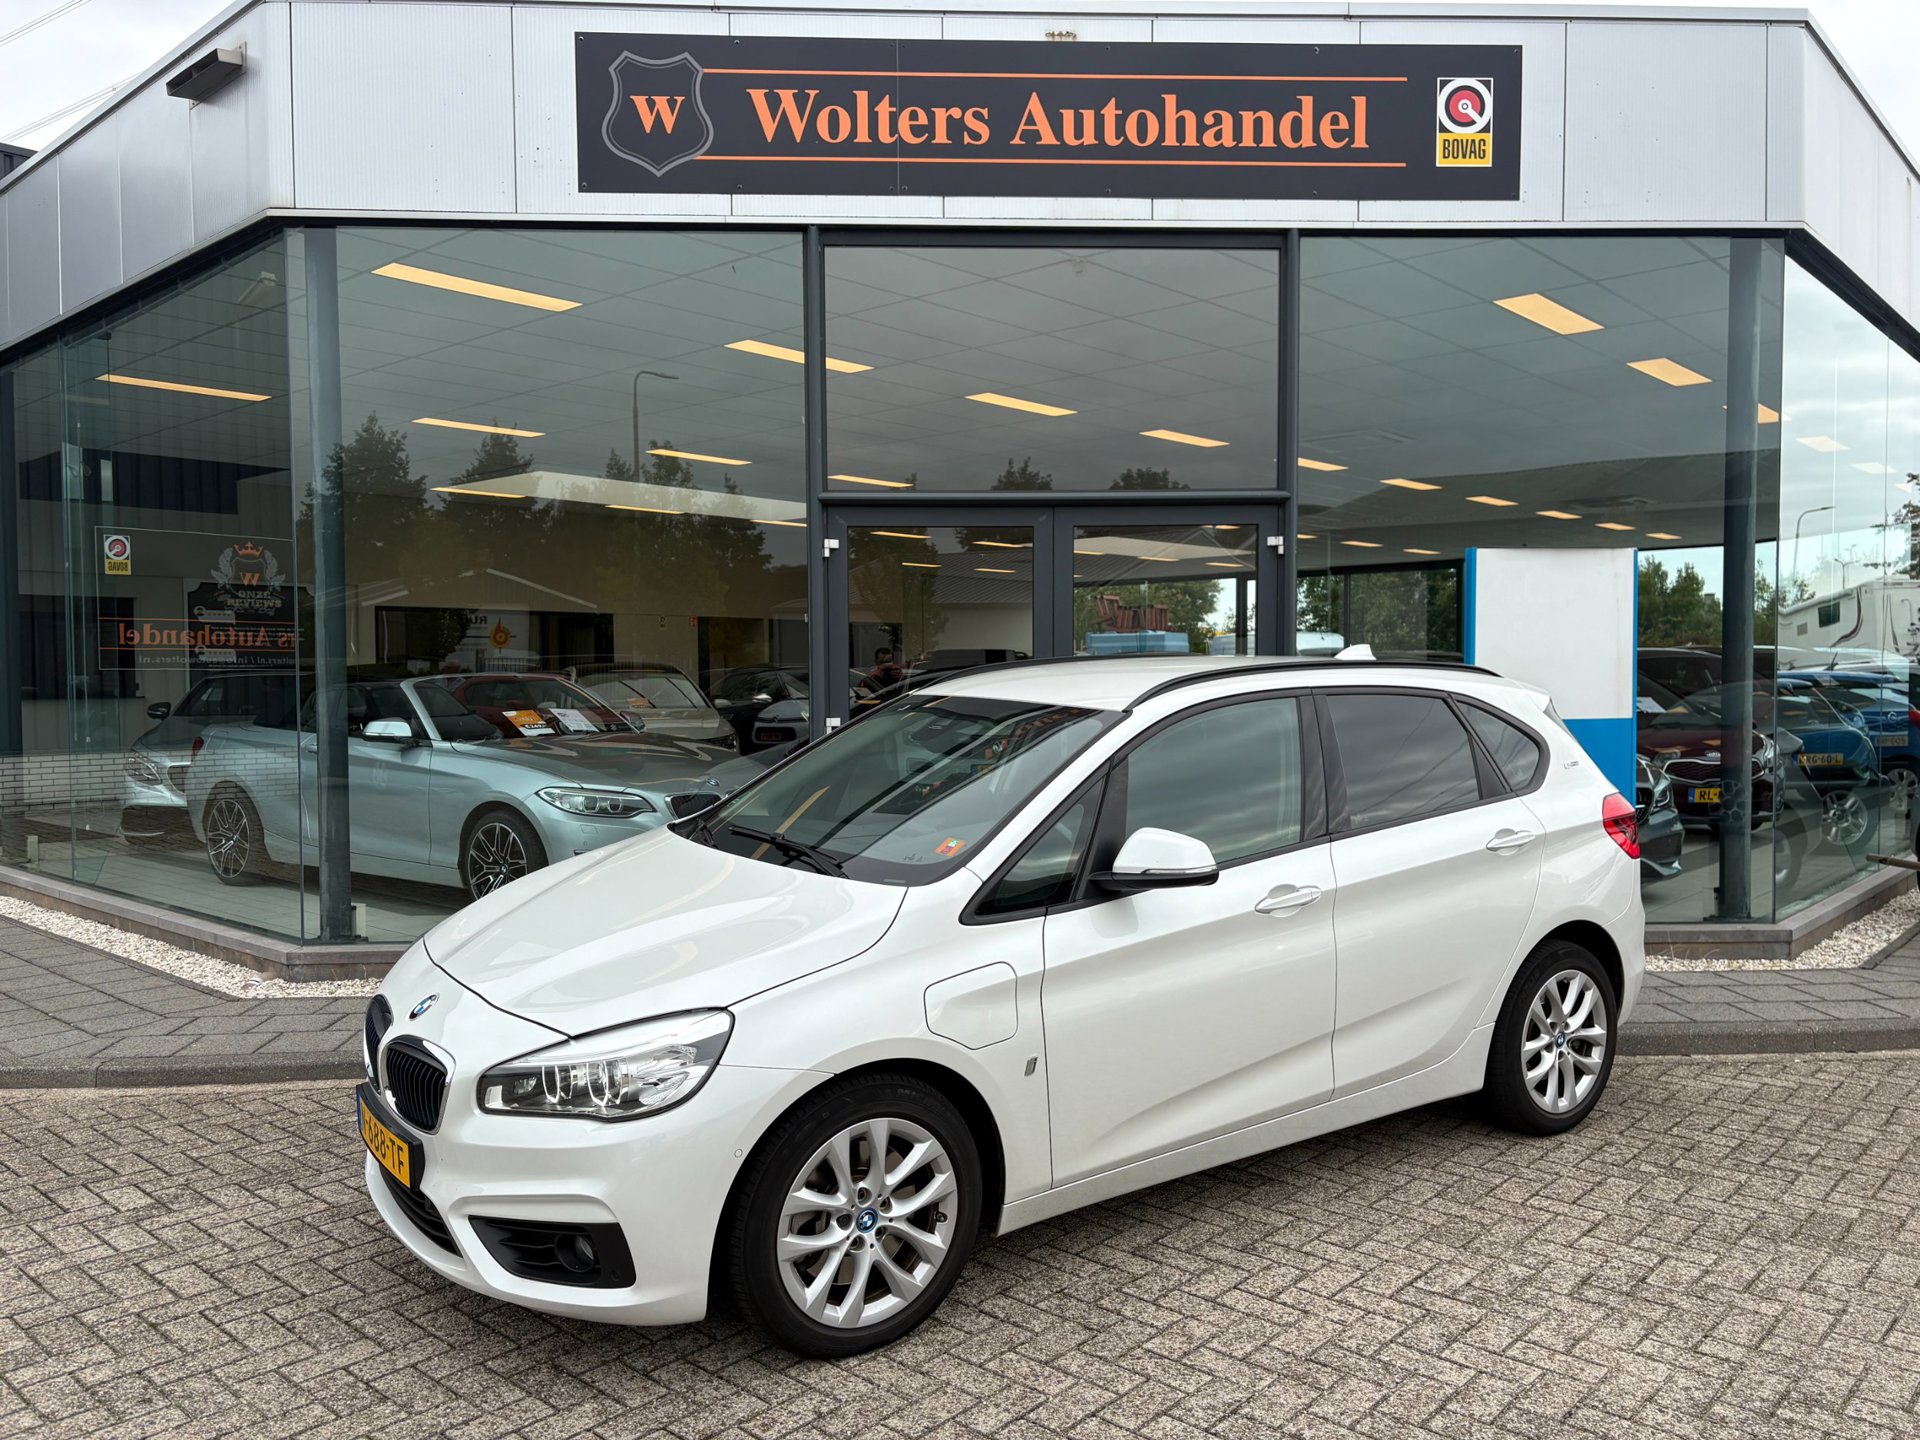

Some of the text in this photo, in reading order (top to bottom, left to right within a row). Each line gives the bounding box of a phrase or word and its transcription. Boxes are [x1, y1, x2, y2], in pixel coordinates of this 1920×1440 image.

[629, 95, 685, 135] W
[746, 88, 1370, 150] Wolters Autohandel
[1442, 137, 1487, 160] BOVAG
